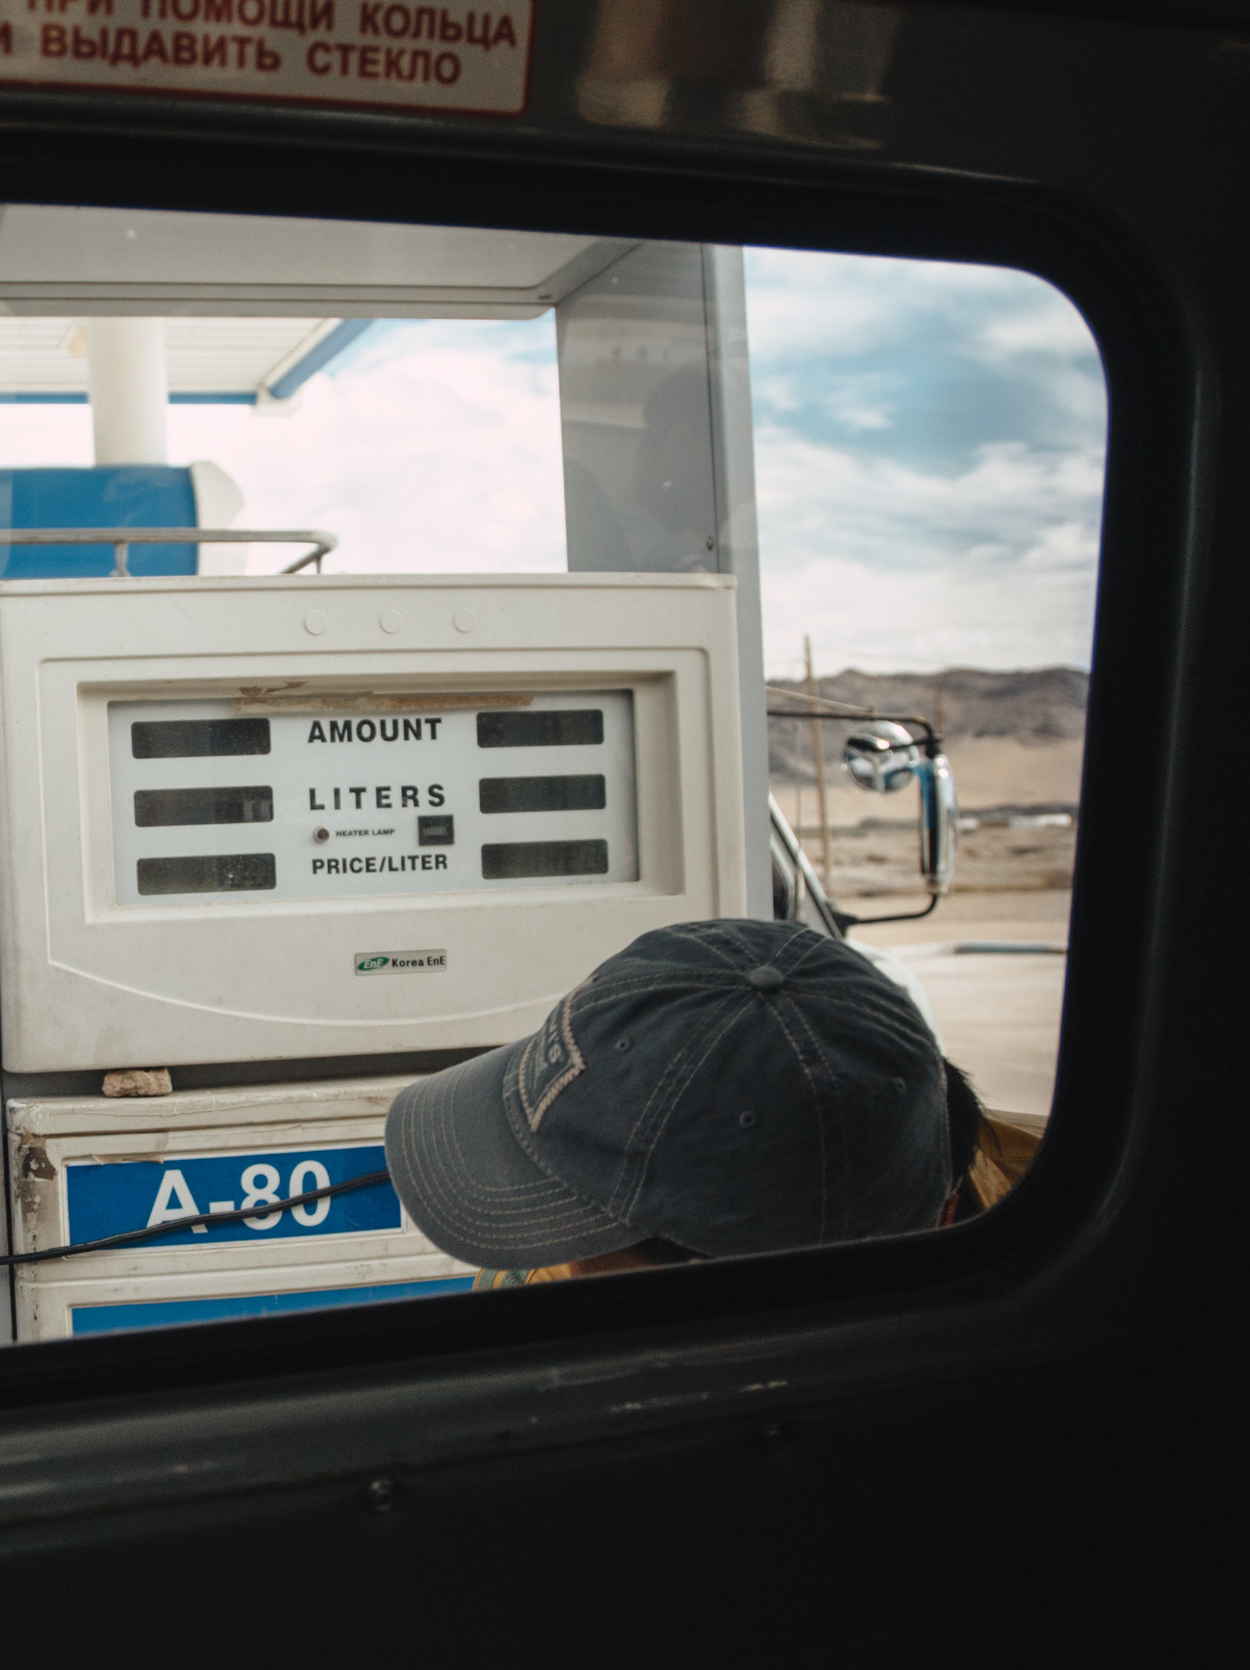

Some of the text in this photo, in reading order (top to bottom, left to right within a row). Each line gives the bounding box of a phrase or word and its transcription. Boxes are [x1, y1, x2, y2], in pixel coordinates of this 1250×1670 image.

[139, 0, 517, 50] ПОМОЩИ КОЛЬЦА
[40, 25, 282, 72] ВЫДАВИТЬ
[306, 41, 462, 85] СТЕКЛО
[307, 717, 442, 744] AMOUNT
[308, 784, 446, 811] LITERS
[335, 828, 396, 838] HEATER LAMP
[312, 853, 449, 875] PRICE/LITER
[391, 957, 425, 968] Korea
[427, 955, 446, 966] EnE
[146, 1160, 332, 1234] A-80
